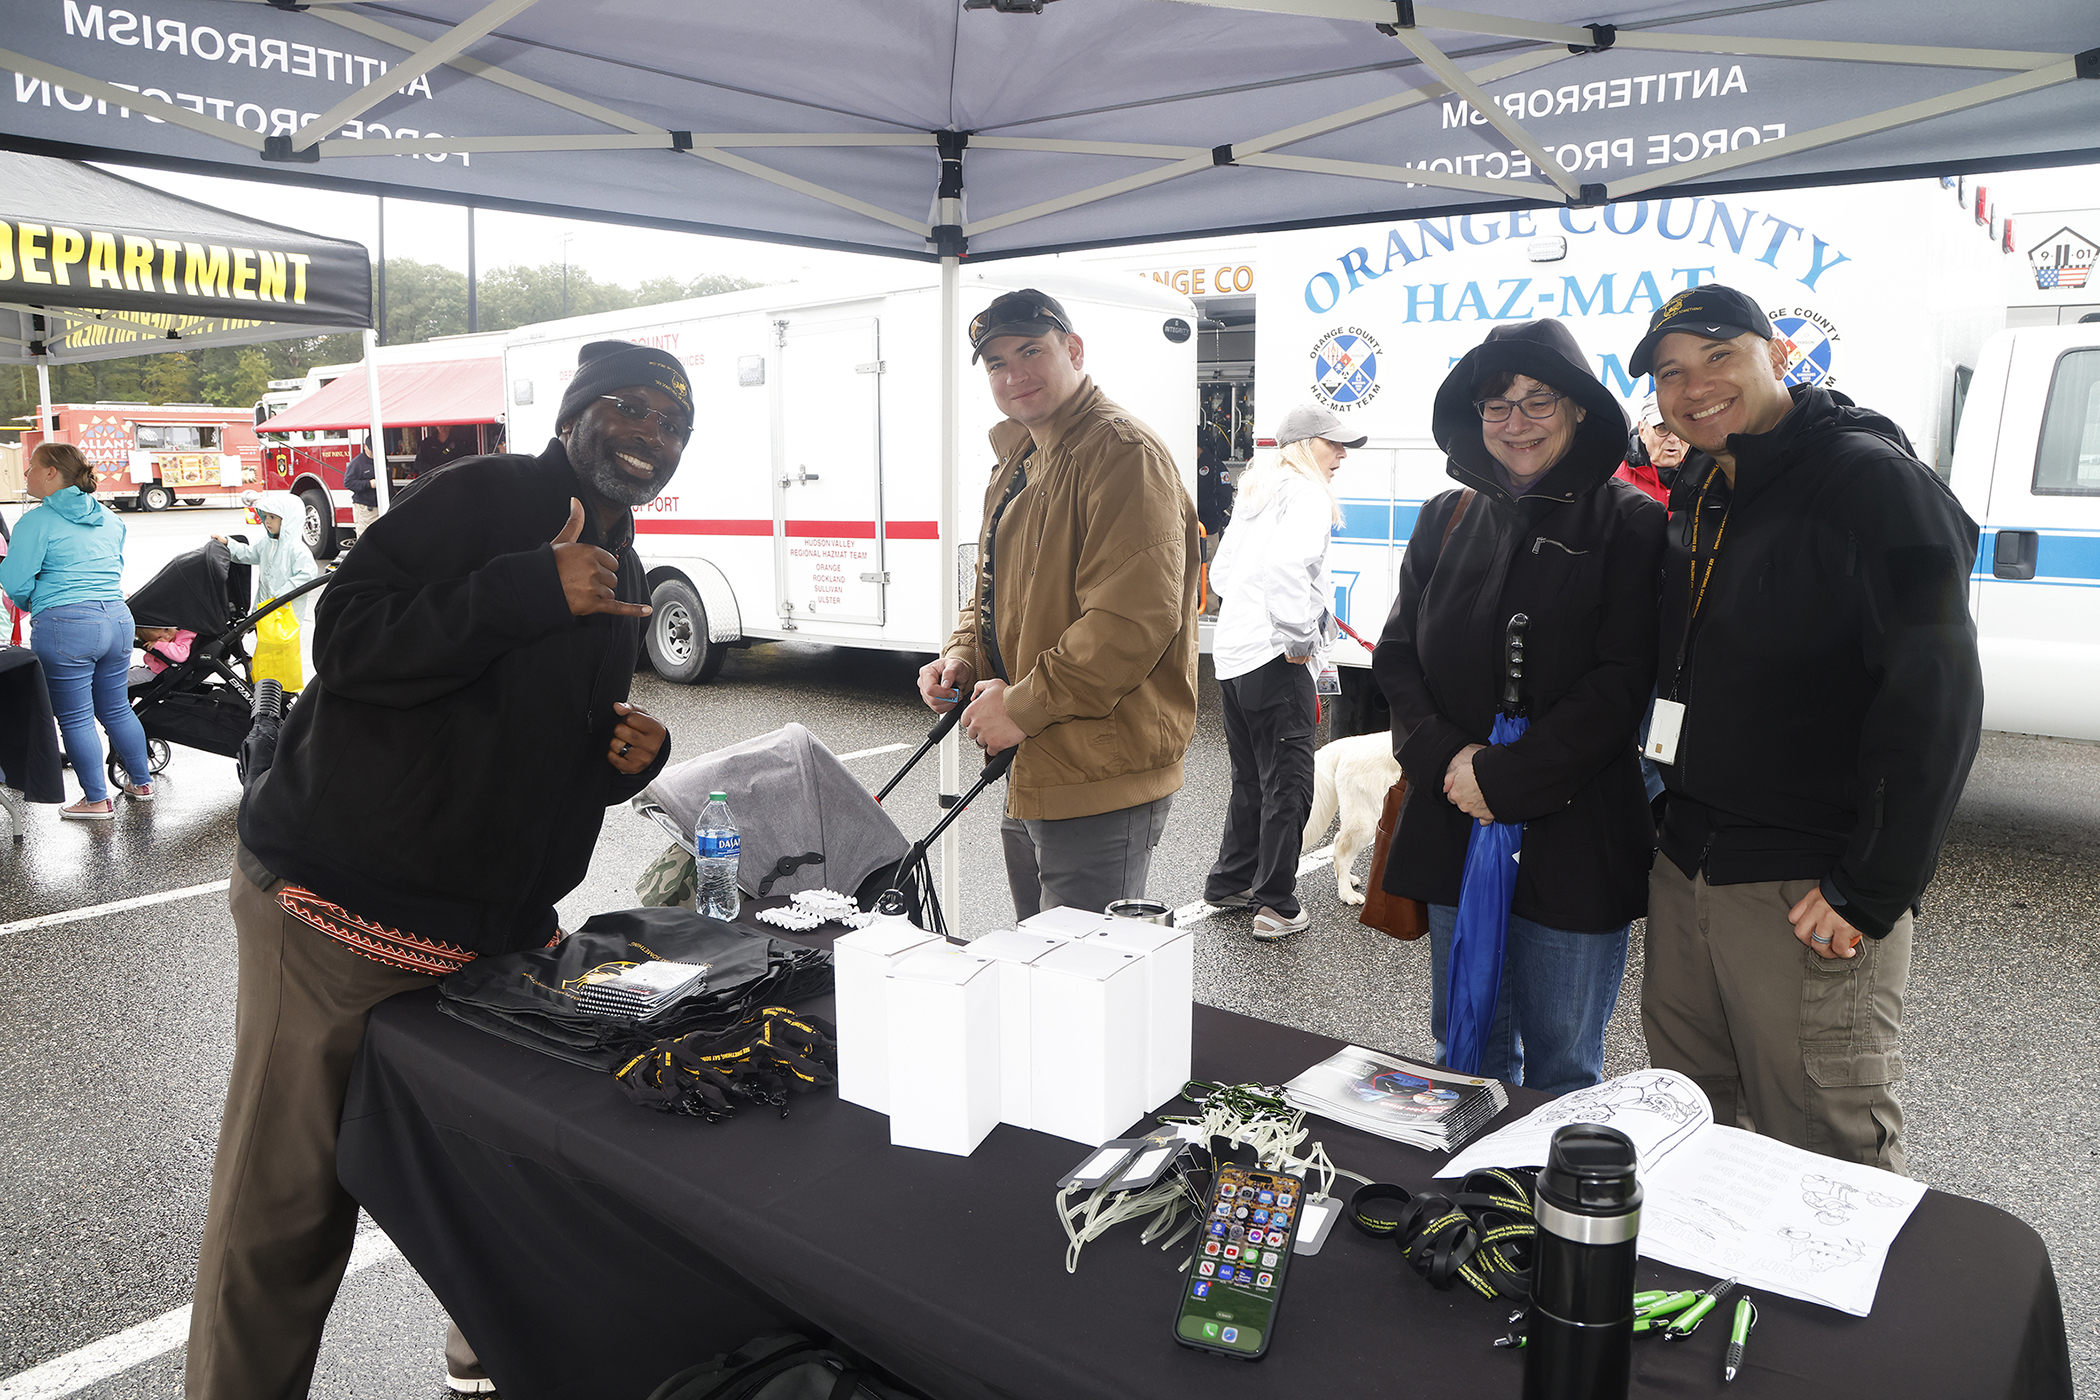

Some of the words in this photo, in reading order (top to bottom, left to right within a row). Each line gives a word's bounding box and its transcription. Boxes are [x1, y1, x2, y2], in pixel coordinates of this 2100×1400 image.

[1303, 211, 1538, 315] ORANGE
[1557, 197, 1853, 294] COUNTY
[1164, 325, 1190, 335] INTEGRITY
[1794, 307, 1841, 343] COUNTY
[1309, 326, 1344, 359] ORANGE
[1348, 326, 1383, 355] COUNTY
[1310, 384, 1352, 412] HAZ-MAT
[1356, 384, 1381, 408] TEAM
[77, 438, 134, 449] ALLAN'S
[804, 539, 832, 547] HUDSON
[832, 539, 855, 548] VALLEY
[790, 549, 821, 558] REGIONAL
[822, 550, 848, 558] HAZMAT
[850, 551, 868, 560] TEAM
[815, 563, 841, 572] ORANGE
[812, 574, 845, 583] ROCKLAND
[814, 585, 843, 593] SULLIVAN
[818, 596, 841, 604] ULSTER
[229, 677, 256, 707] BRAV
[1729, 1143, 1766, 1165] home
[1770, 1143, 1797, 1159] and
[1704, 1147, 1763, 1175] knowing
[1768, 1155, 1800, 1175] your
[1798, 1152, 1829, 1170] safe
[1831, 1162, 1846, 1173] is
[1698, 1174, 1727, 1189] can
[1712, 1164, 1739, 1182] the
[1764, 1166, 1789, 1185] trip
[1738, 1172, 1777, 1194] enjoy
[1691, 1185, 1728, 1203] your
[1729, 1183, 1773, 1206] family
[1727, 1197, 1764, 1220] Then
[1645, 1217, 1717, 1255] Sand
[1264, 1256, 1275, 1265] 30
[1724, 1247, 1745, 1266] &
[1748, 1257, 1813, 1285] Surf
